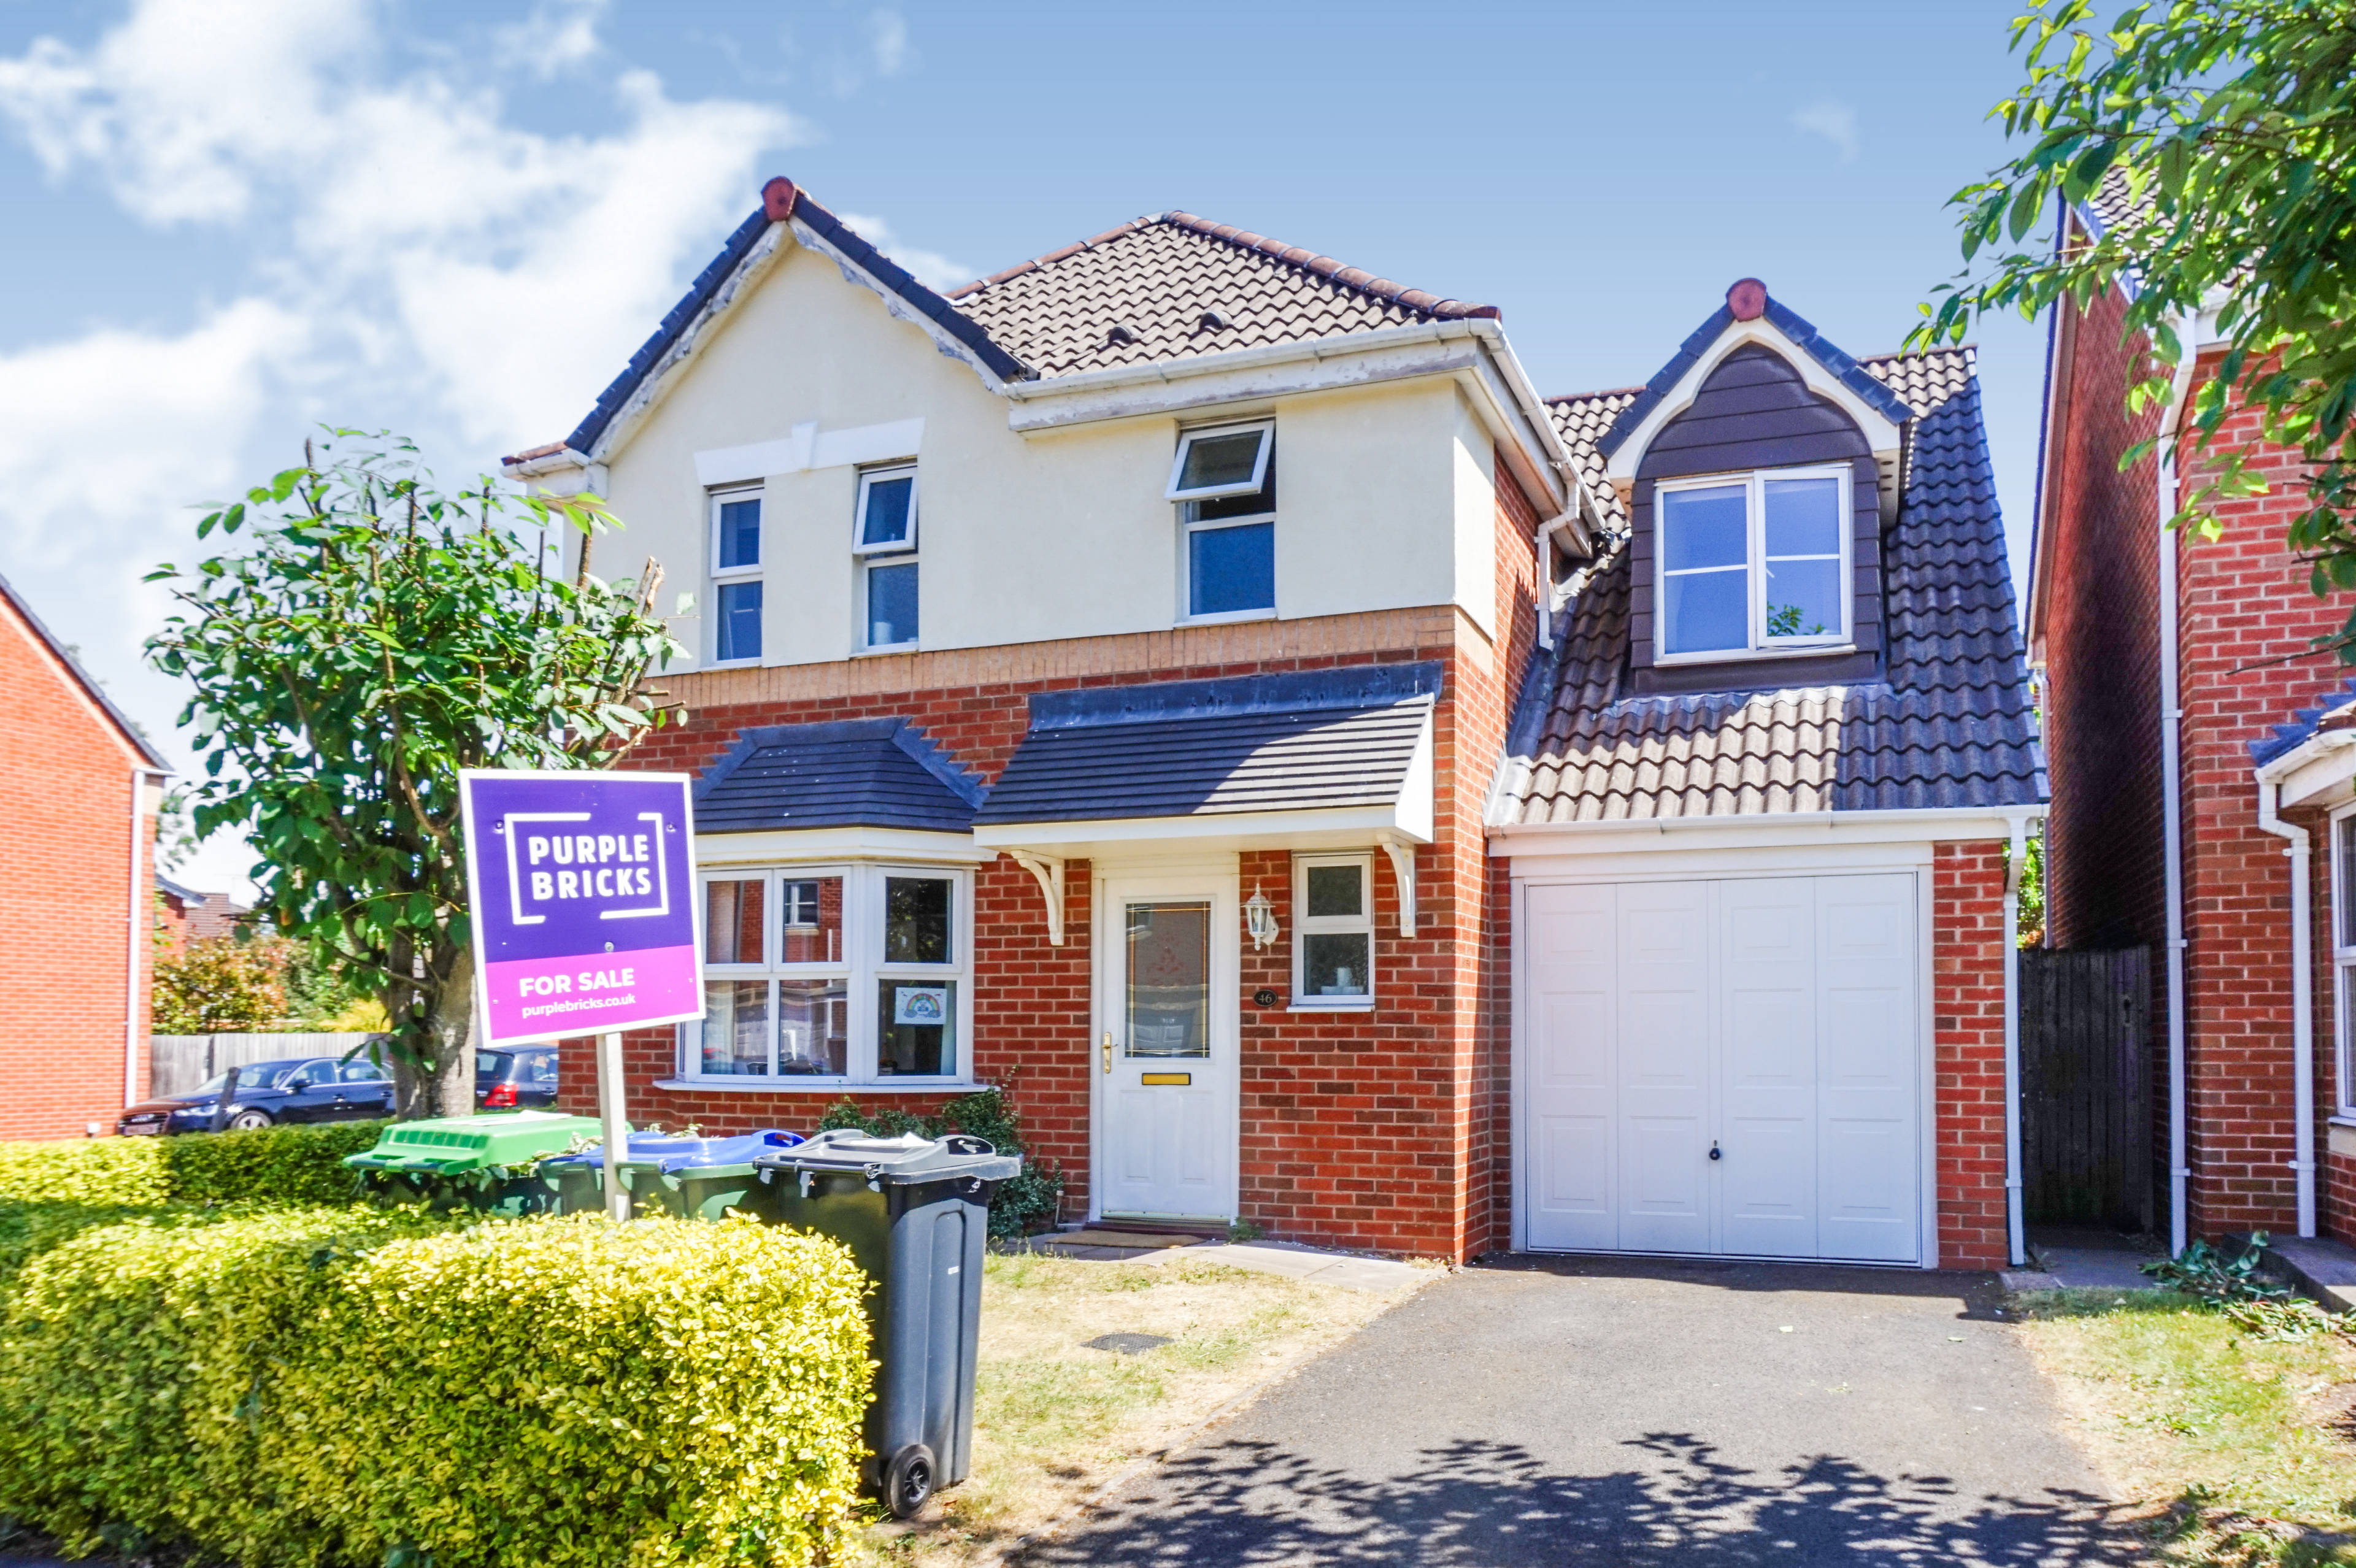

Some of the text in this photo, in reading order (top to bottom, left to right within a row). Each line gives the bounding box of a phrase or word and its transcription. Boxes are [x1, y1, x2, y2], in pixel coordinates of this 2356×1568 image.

[528, 835, 649, 865] PURPLE
[531, 868, 652, 900] BRICKS
[519, 968, 635, 997] FOR SALE
[522, 993, 636, 1018] purplebricks.co.uk
[1258, 994, 1272, 1003] 46
